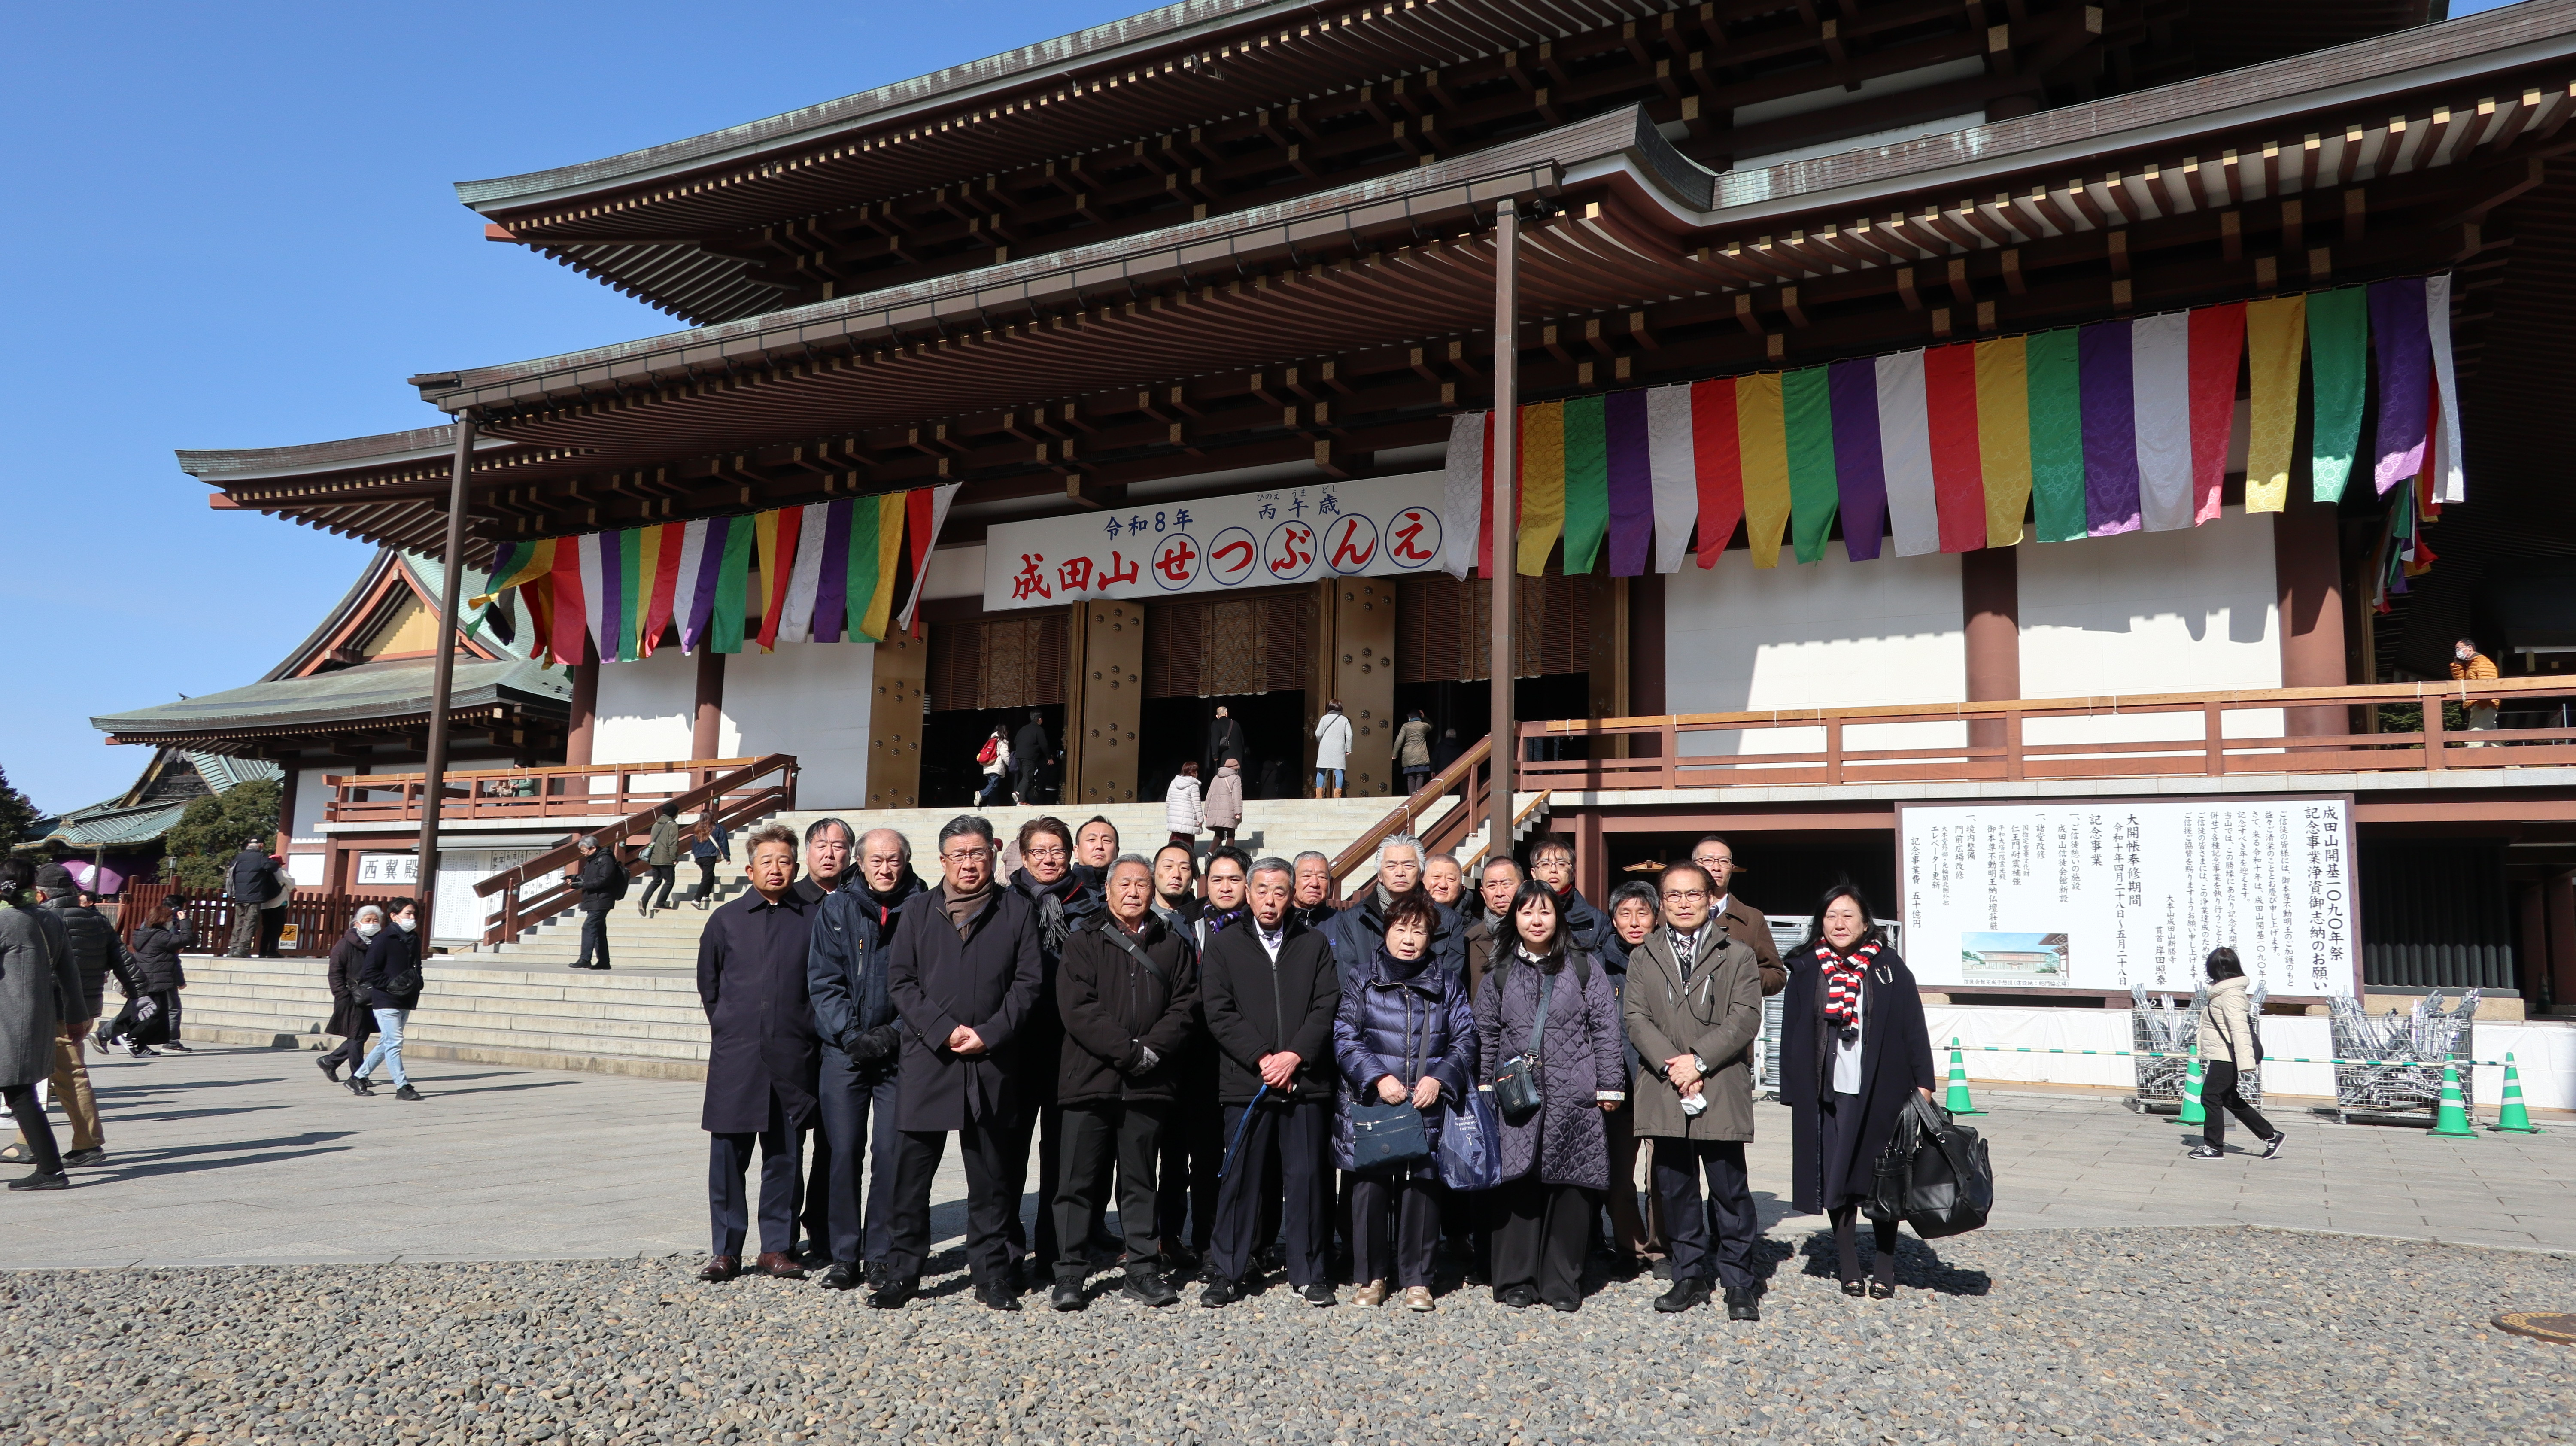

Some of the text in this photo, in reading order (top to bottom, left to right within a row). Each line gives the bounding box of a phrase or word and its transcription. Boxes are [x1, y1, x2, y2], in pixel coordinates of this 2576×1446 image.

[1103, 508, 1194, 540] 令和8年
[1257, 485, 1337, 501] ひのえ うま どし
[1258, 494, 1340, 520] 丙午歳
[1011, 512, 1432, 600] 成田山せつぶんえ
[364, 859, 418, 879] 西翼殿
[1955, 825, 1965, 880] 門前広場改修
[2011, 825, 2022, 886] 仁王門耐震補強
[2057, 824, 2069, 903] 成田山信徒会館新設
[2089, 814, 2103, 866] 記念事業
[2126, 814, 2142, 907] 大開帳奉修期間
[2237, 811, 2250, 902] 記念すべき年を迎えます。
[1911, 837, 1921, 928] 記念事業費 五十億円
[2304, 807, 2328, 990] 記念事業浄資御志納のお願い
[2322, 806, 2345, 960] 成田山開基一〇九〇年祭
[2155, 926, 2167, 985] 貫首 岸田照泰
[2166, 894, 2177, 964] 大本山成田山新勝寺
